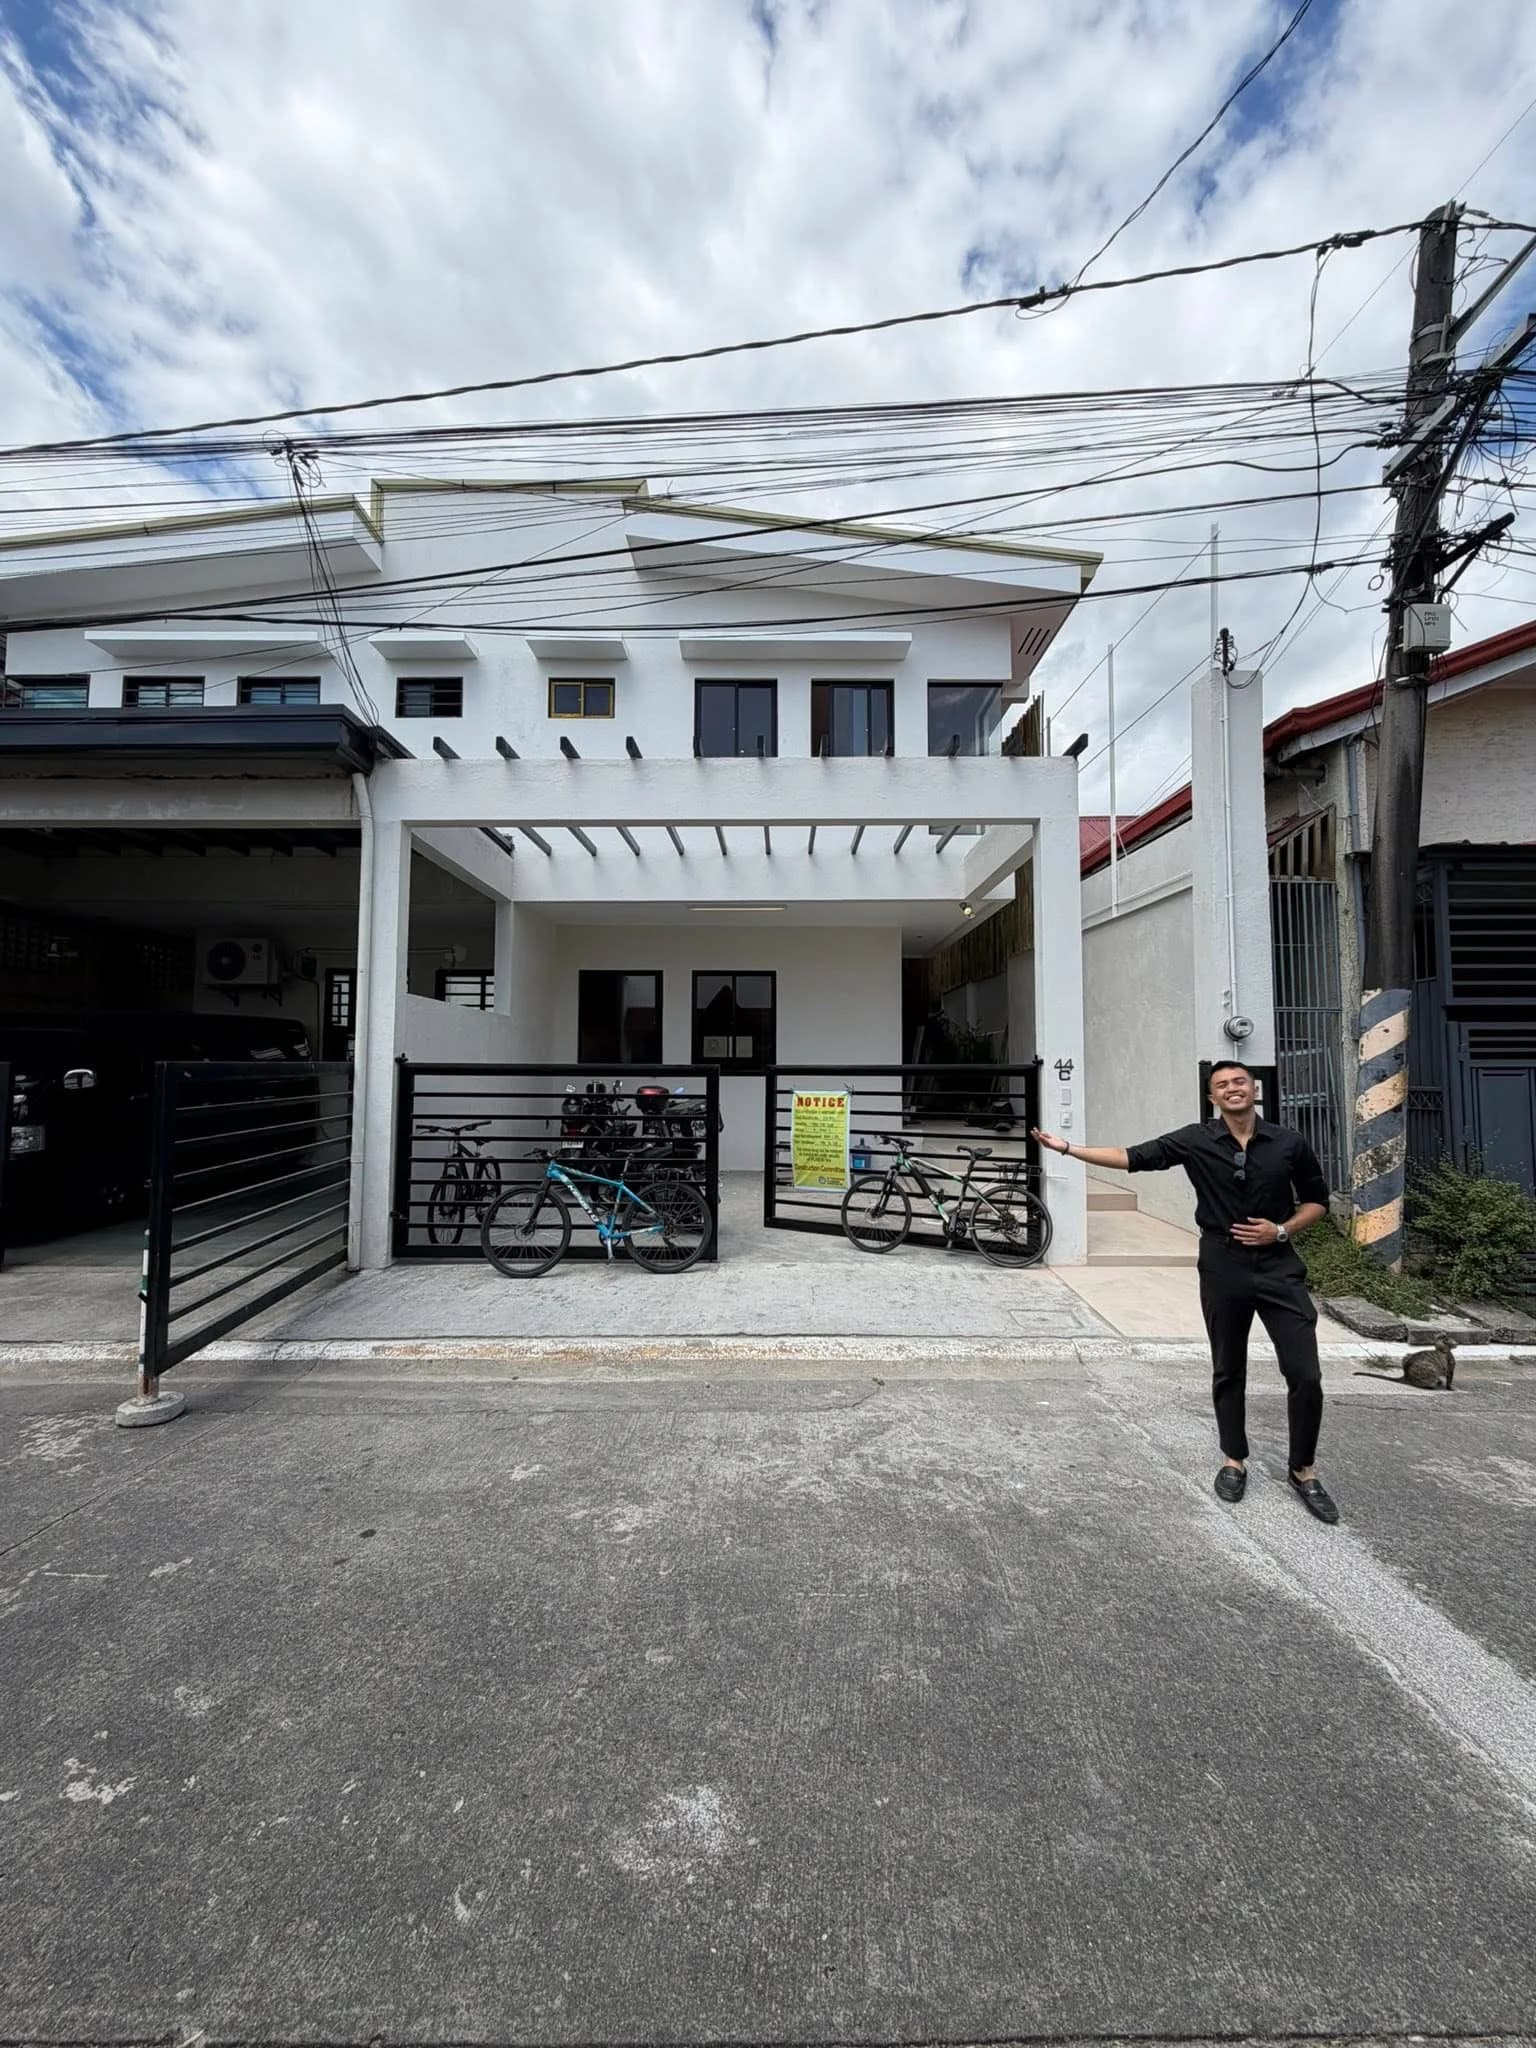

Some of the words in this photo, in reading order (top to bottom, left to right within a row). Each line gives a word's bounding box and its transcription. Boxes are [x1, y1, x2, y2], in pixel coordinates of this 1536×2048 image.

[1054, 1058, 1074, 1071] 44
[1058, 1070, 1071, 1081] C
[797, 1096, 845, 1107] NOTICE
